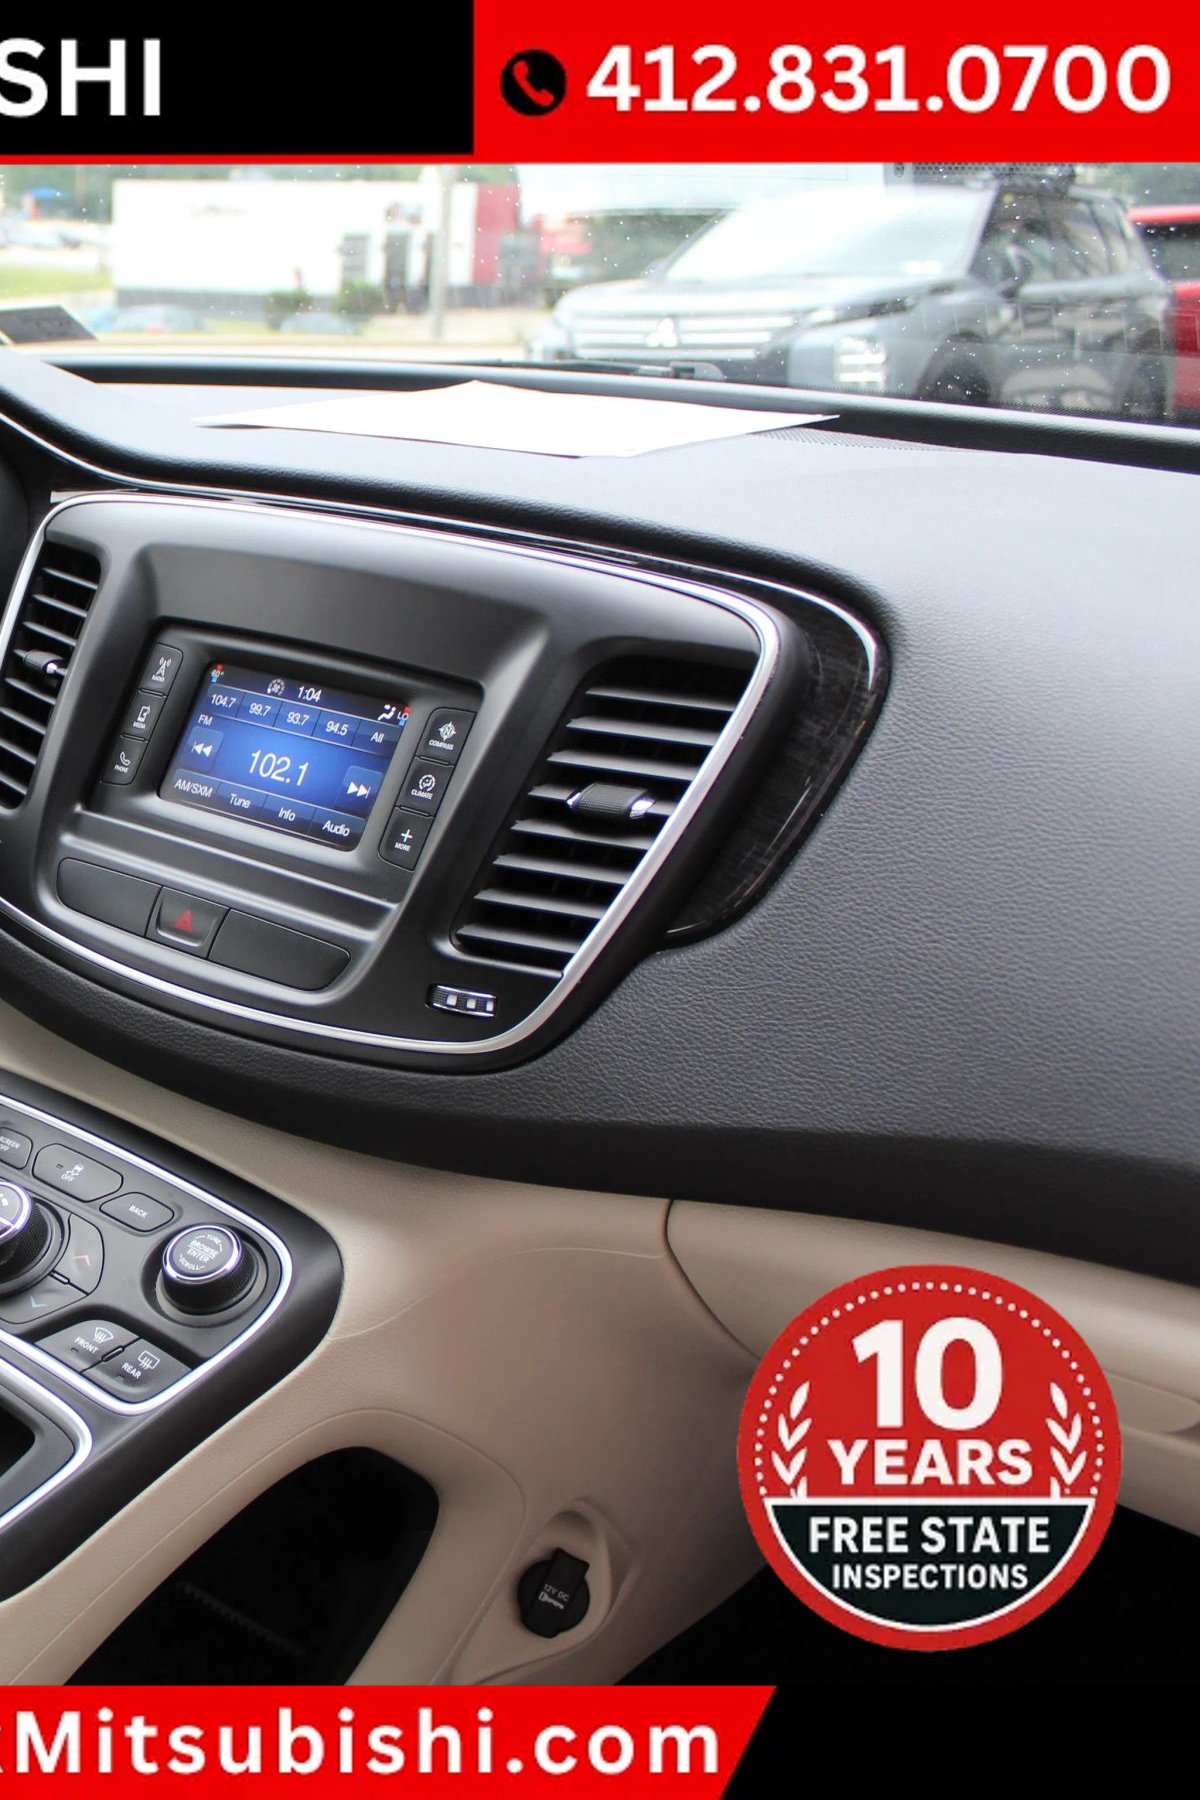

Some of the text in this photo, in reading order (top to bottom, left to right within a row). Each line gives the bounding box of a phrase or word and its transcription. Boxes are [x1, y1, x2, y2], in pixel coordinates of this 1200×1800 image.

[211, 694, 236, 708] 104.7
[297, 686, 322, 703] 1:04
[249, 702, 271, 717] 99.7
[198, 714, 213, 726] FM
[287, 711, 309, 726] 93.7
[325, 721, 348, 736] 94.5
[370, 731, 385, 743] All
[249, 750, 309, 787] 102.1
[174, 779, 213, 798] AM/SXM
[410, 788, 434, 800] CLIMATE
[229, 793, 251, 808] Tune
[278, 807, 296, 822] Info
[322, 820, 350, 837] Audio
[394, 841, 412, 852] MORE
[60, 1172, 76, 1183] OFF
[128, 1204, 149, 1219] BACK
[186, 1248, 211, 1263] ENTER
[74, 1336, 99, 1354] FRONT
[121, 1361, 142, 1380] REAR
